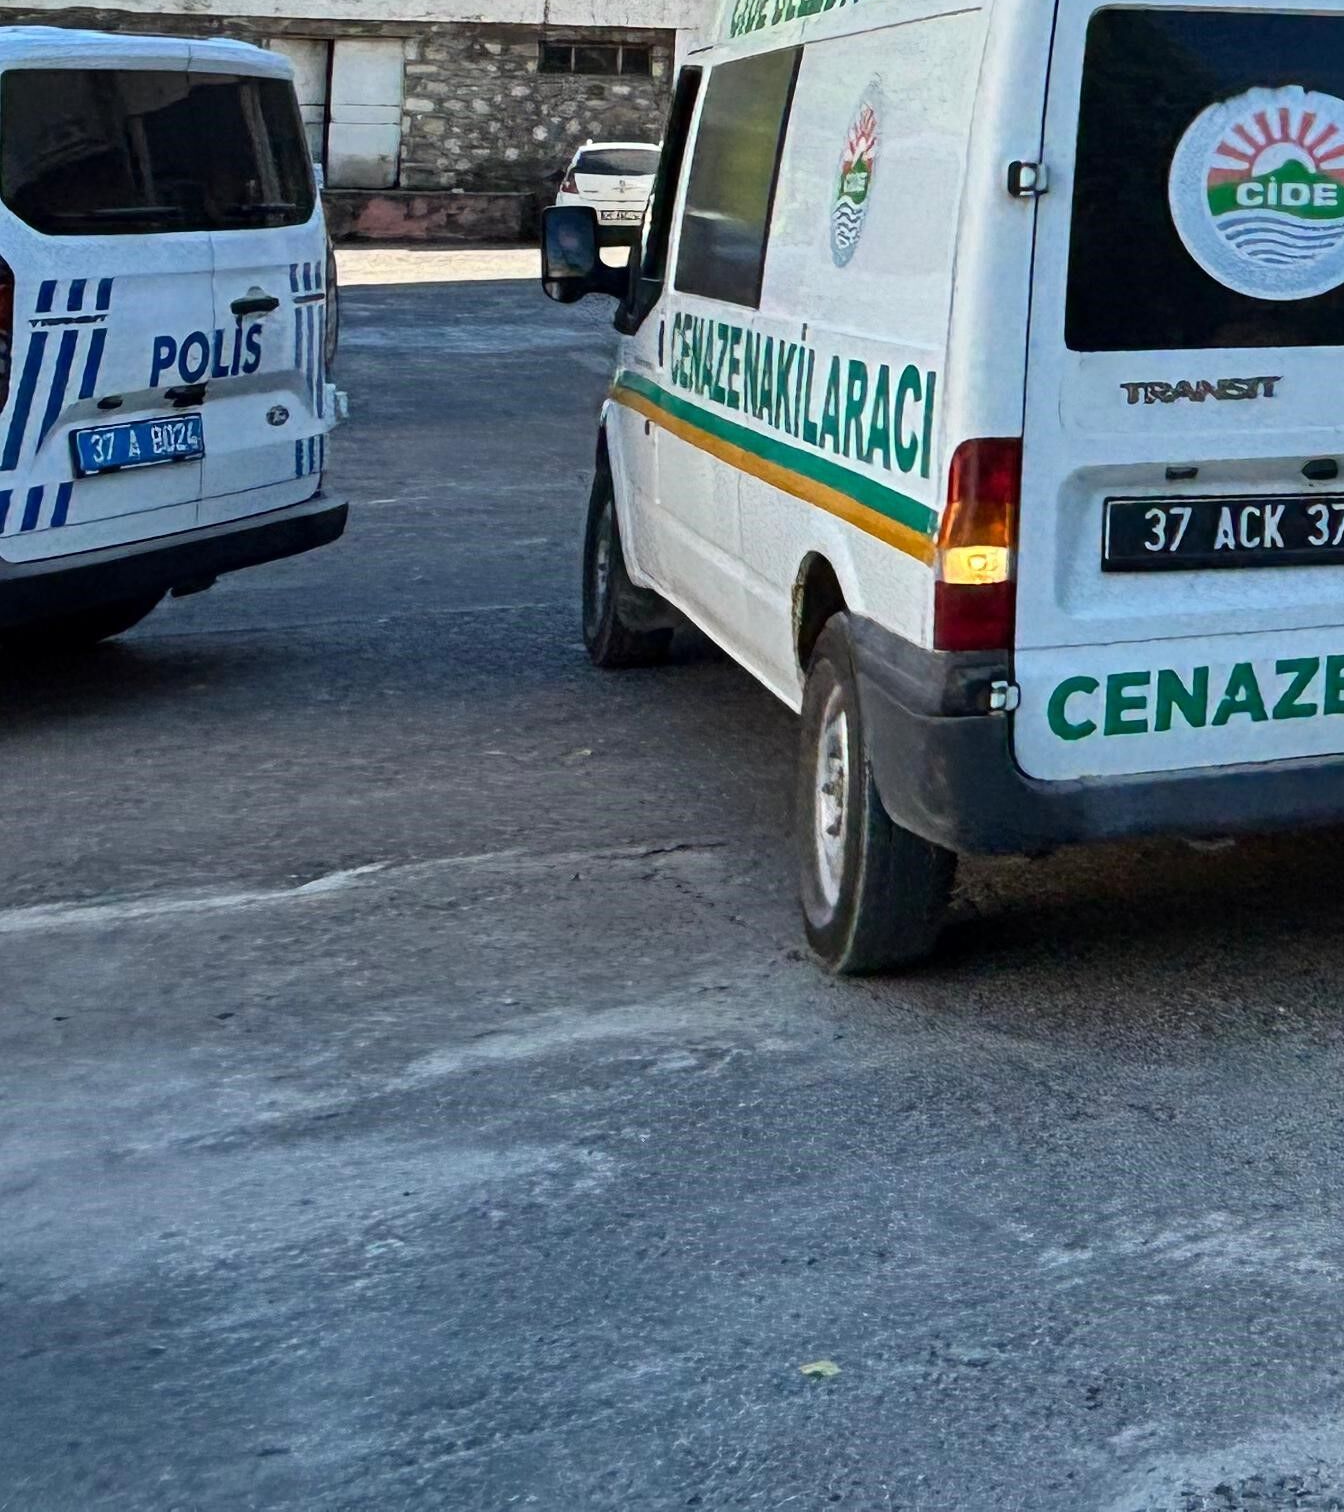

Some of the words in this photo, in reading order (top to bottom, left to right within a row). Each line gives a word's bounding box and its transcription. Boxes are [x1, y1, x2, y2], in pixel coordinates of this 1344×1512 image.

[1236, 176, 1339, 207] CİDE
[150, 316, 263, 388] POLİS
[90, 431, 116, 464] 37
[128, 429, 142, 460] A
[1143, 505, 1193, 552] 37
[1213, 503, 1286, 551] ACK
